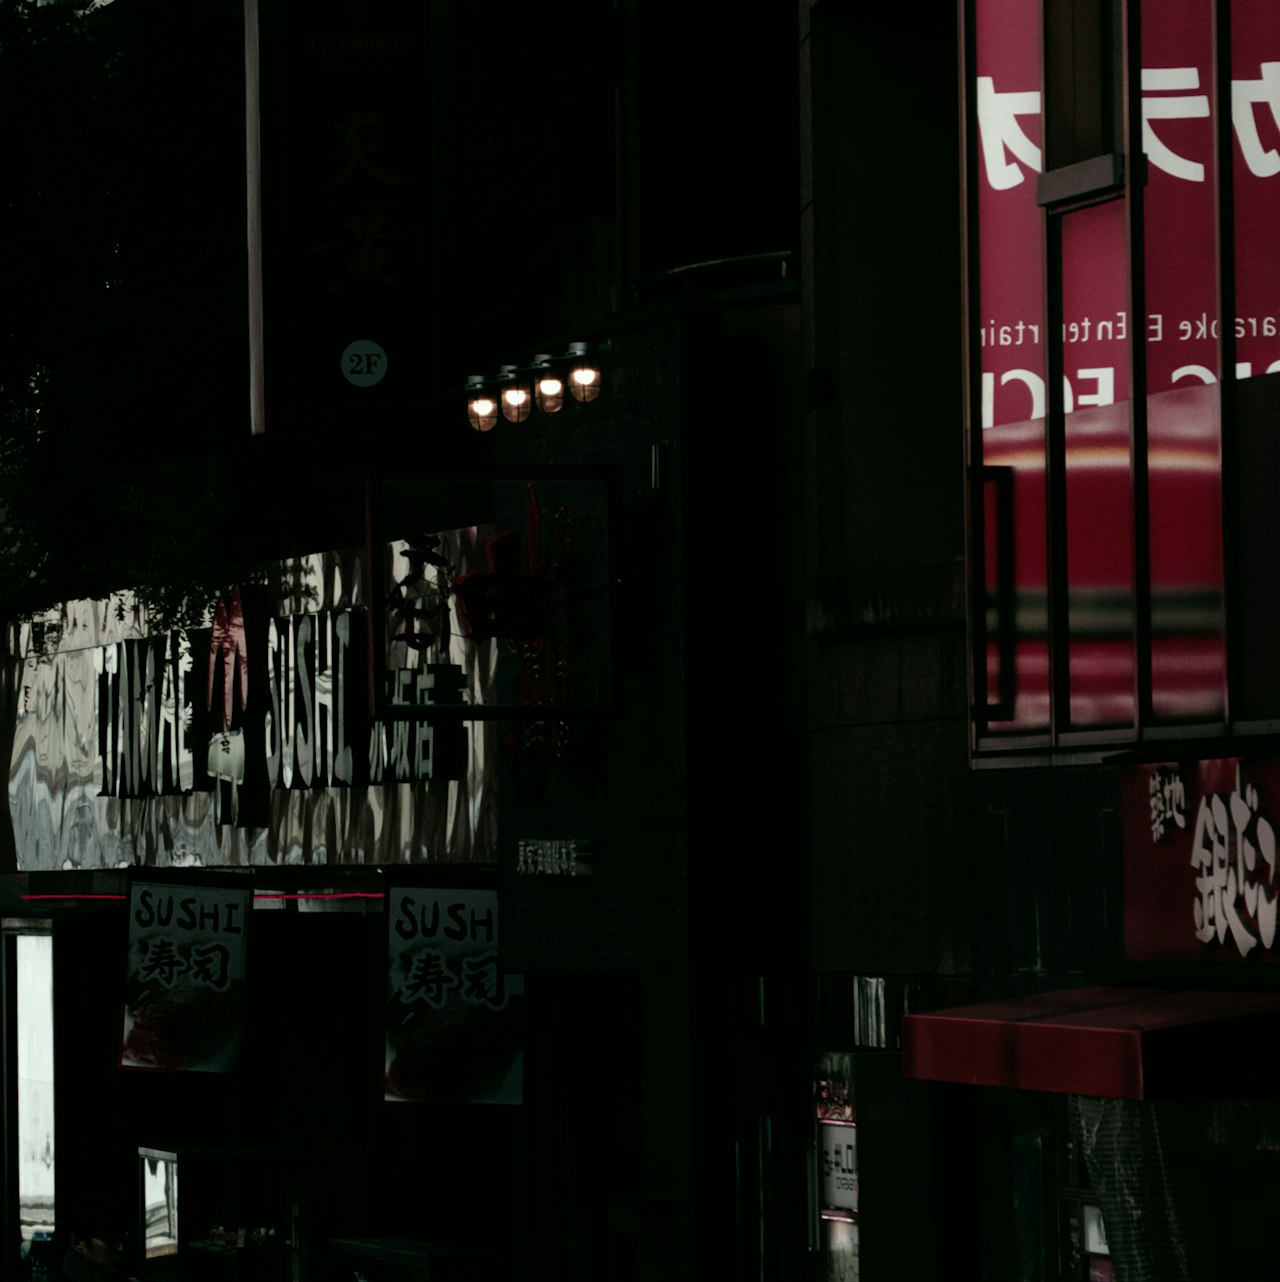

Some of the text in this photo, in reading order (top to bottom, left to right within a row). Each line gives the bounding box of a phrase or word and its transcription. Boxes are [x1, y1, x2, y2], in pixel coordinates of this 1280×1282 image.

[349, 353, 380, 375] 2F
[265, 612, 353, 791] SUSHI
[135, 890, 242, 934] SUSHI
[395, 896, 494, 943] SUSH
[140, 938, 231, 991] 寿司
